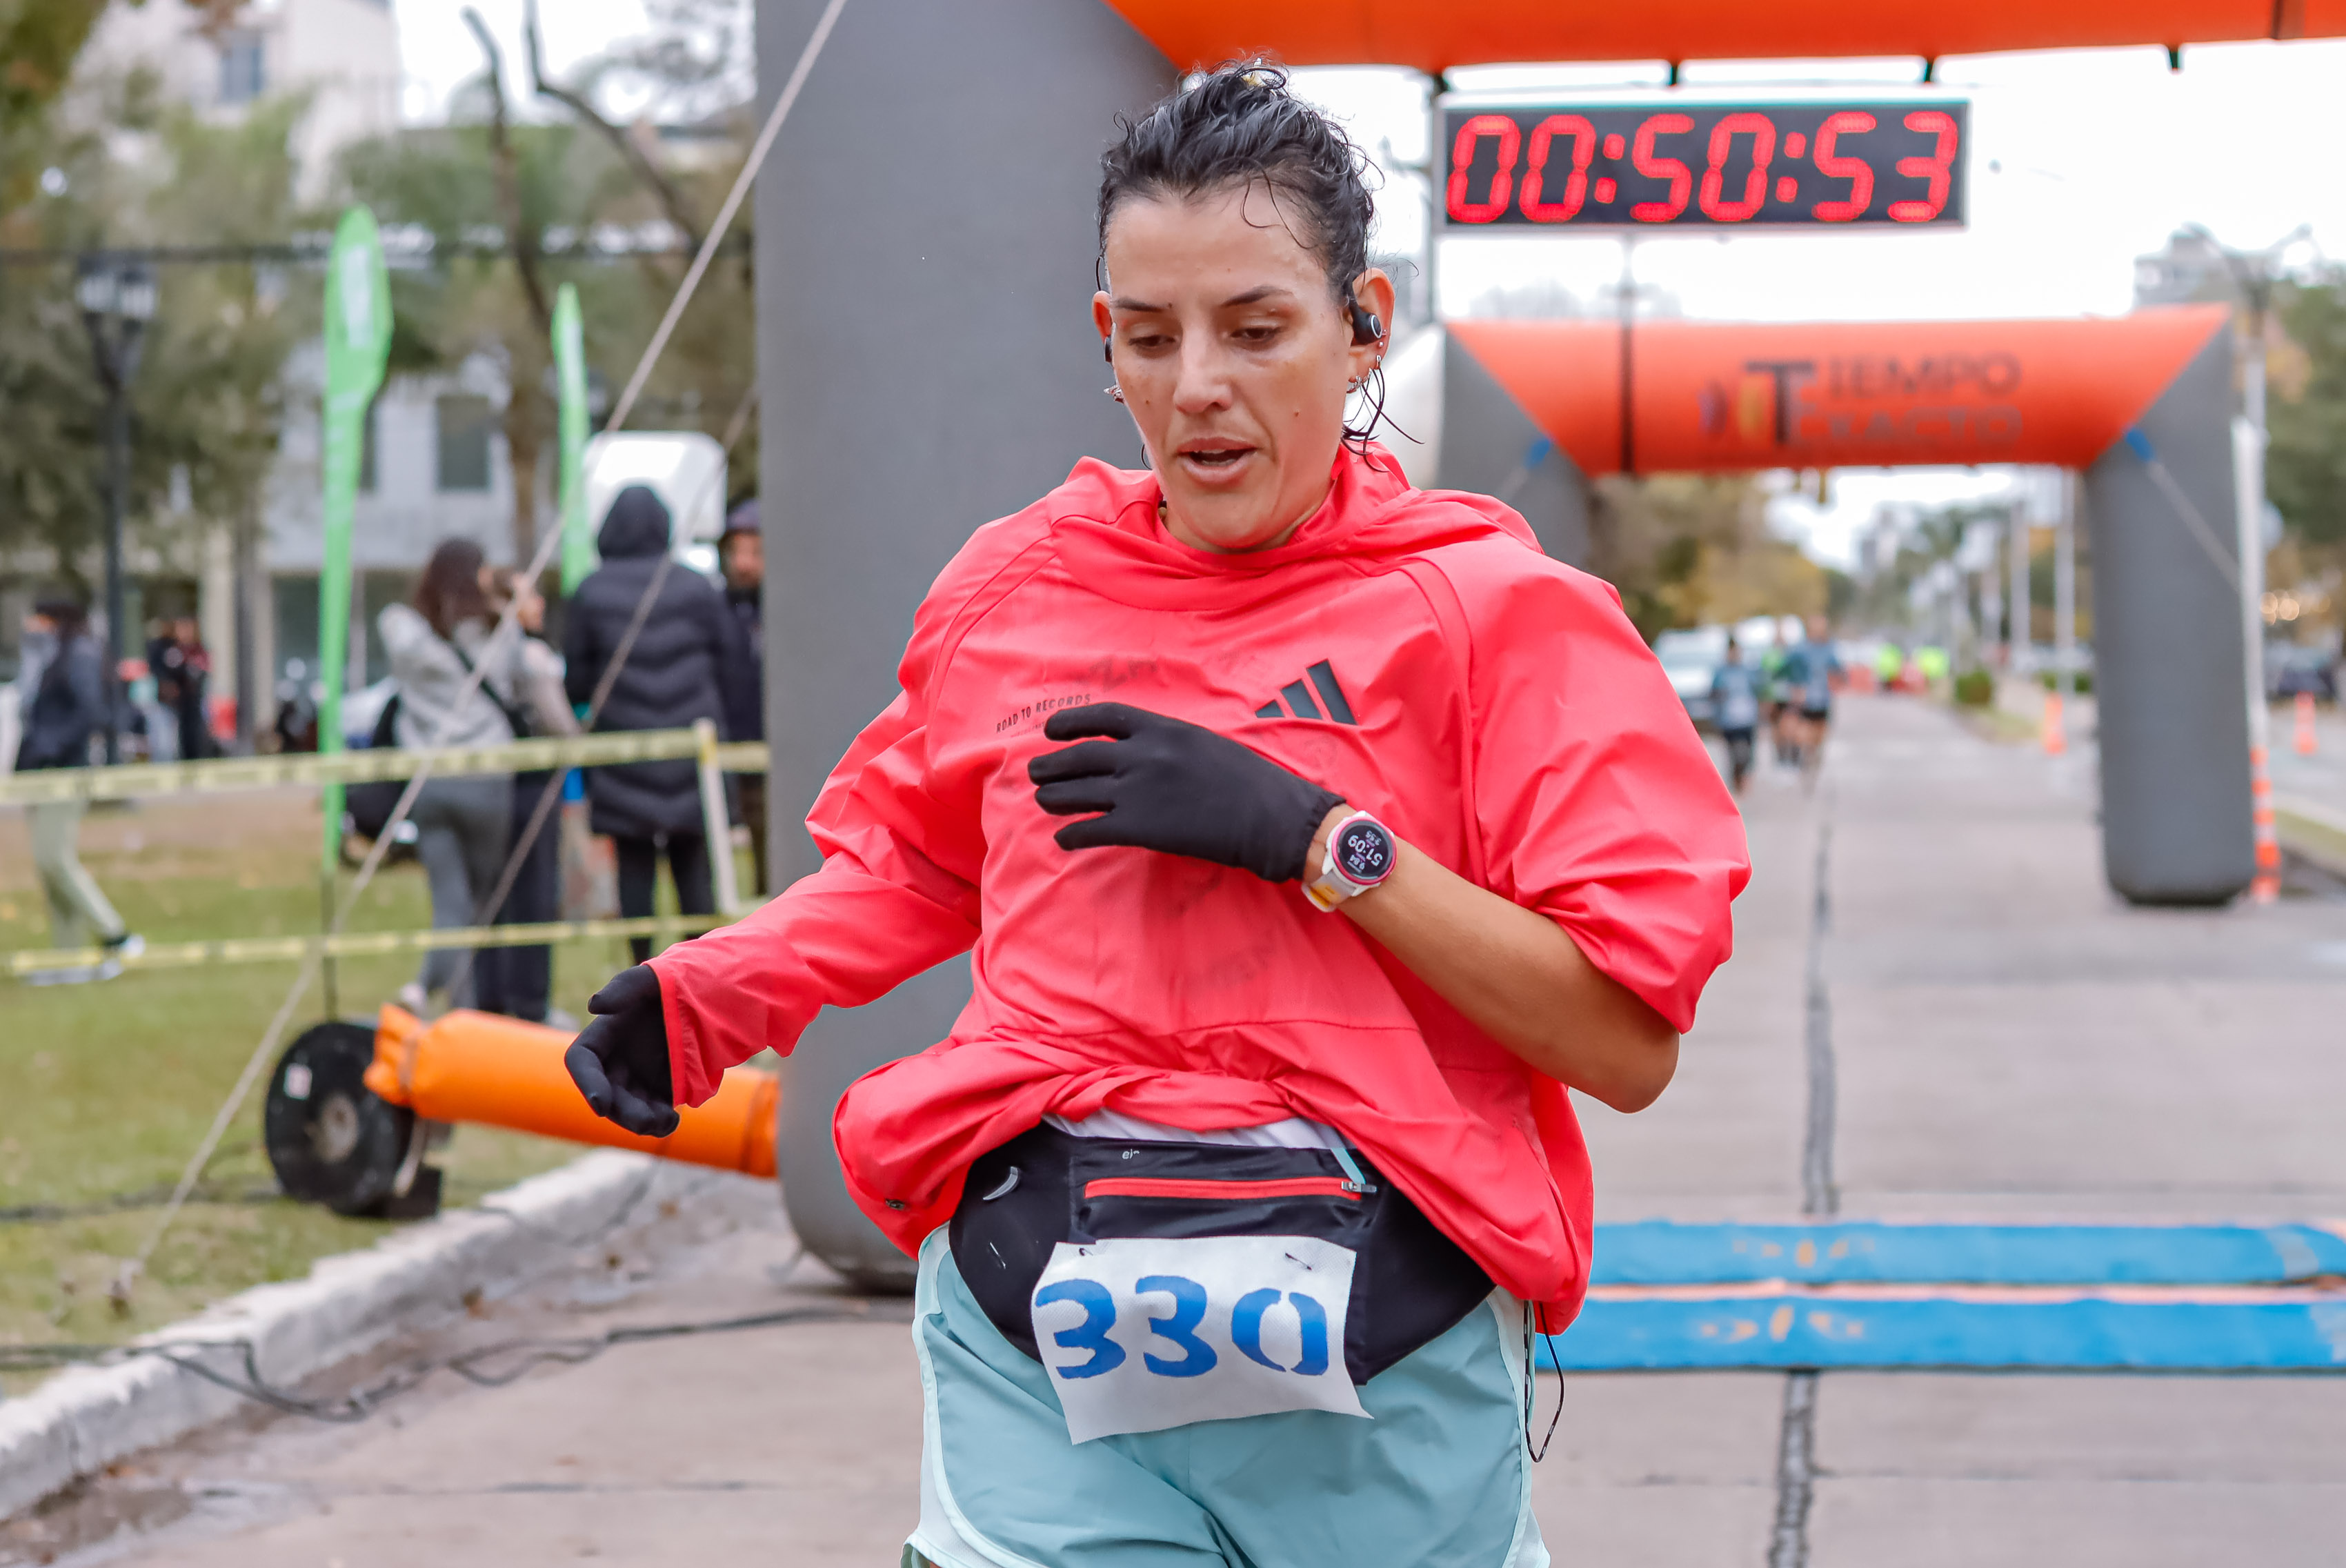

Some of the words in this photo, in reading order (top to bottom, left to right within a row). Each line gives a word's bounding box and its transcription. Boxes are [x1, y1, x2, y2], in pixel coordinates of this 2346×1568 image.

[1446, 112, 1959, 223] 00:50:53
[997, 713, 1019, 733] ROAD
[1021, 706, 1031, 720] TO
[1036, 694, 1091, 713] RECORDS
[1347, 835, 1383, 866] 51:09
[1035, 1275, 1329, 1379] 330
